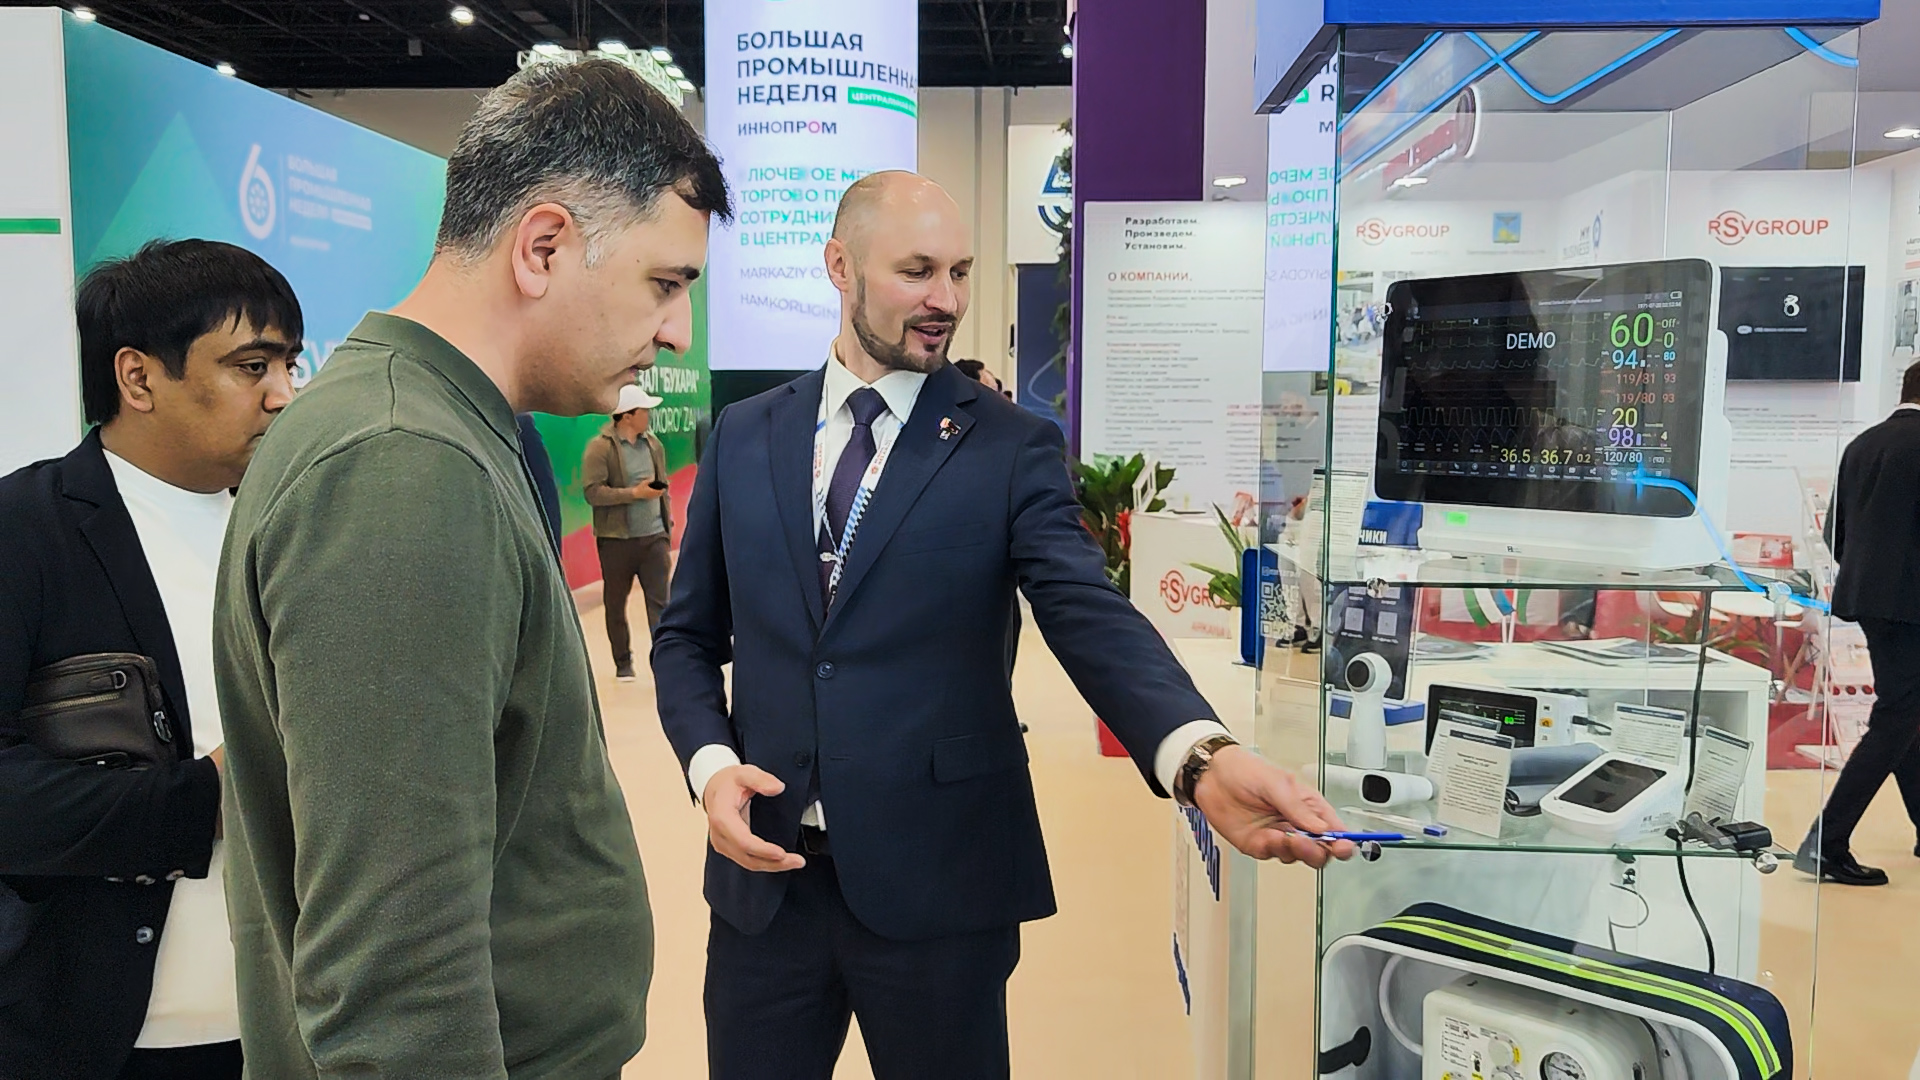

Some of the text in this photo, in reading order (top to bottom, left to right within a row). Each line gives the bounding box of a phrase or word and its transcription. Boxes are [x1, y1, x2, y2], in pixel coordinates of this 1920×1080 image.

[737, 29, 864, 52] БОЛЬШАЯ
[737, 83, 838, 107] НЕДЕЛЯ
[737, 120, 838, 136] ИННОПРОМ
[1124, 229, 1197, 239] Произведем.
[1355, 221, 1450, 241] RSVGROUP
[1708, 214, 1829, 239] RSVGROUP
[740, 232, 750, 246] В
[1124, 242, 1188, 250] Установим.
[1107, 272, 1117, 282] О
[1610, 312, 1654, 349] 60
[1661, 318, 1677, 329] Off
[1506, 331, 1556, 350] DEMO
[1663, 331, 1675, 349] 0
[1612, 349, 1638, 370] 94
[1663, 351, 1676, 361] 80
[1663, 373, 1677, 384] 93
[1662, 393, 1675, 404] 93
[1611, 407, 1638, 428] 20
[1608, 427, 1634, 448] 98
[1660, 431, 1668, 441] 4
[1500, 449, 1531, 464] 36.5
[1540, 449, 1573, 465] 36.7
[1604, 451, 1643, 463] 120/80
